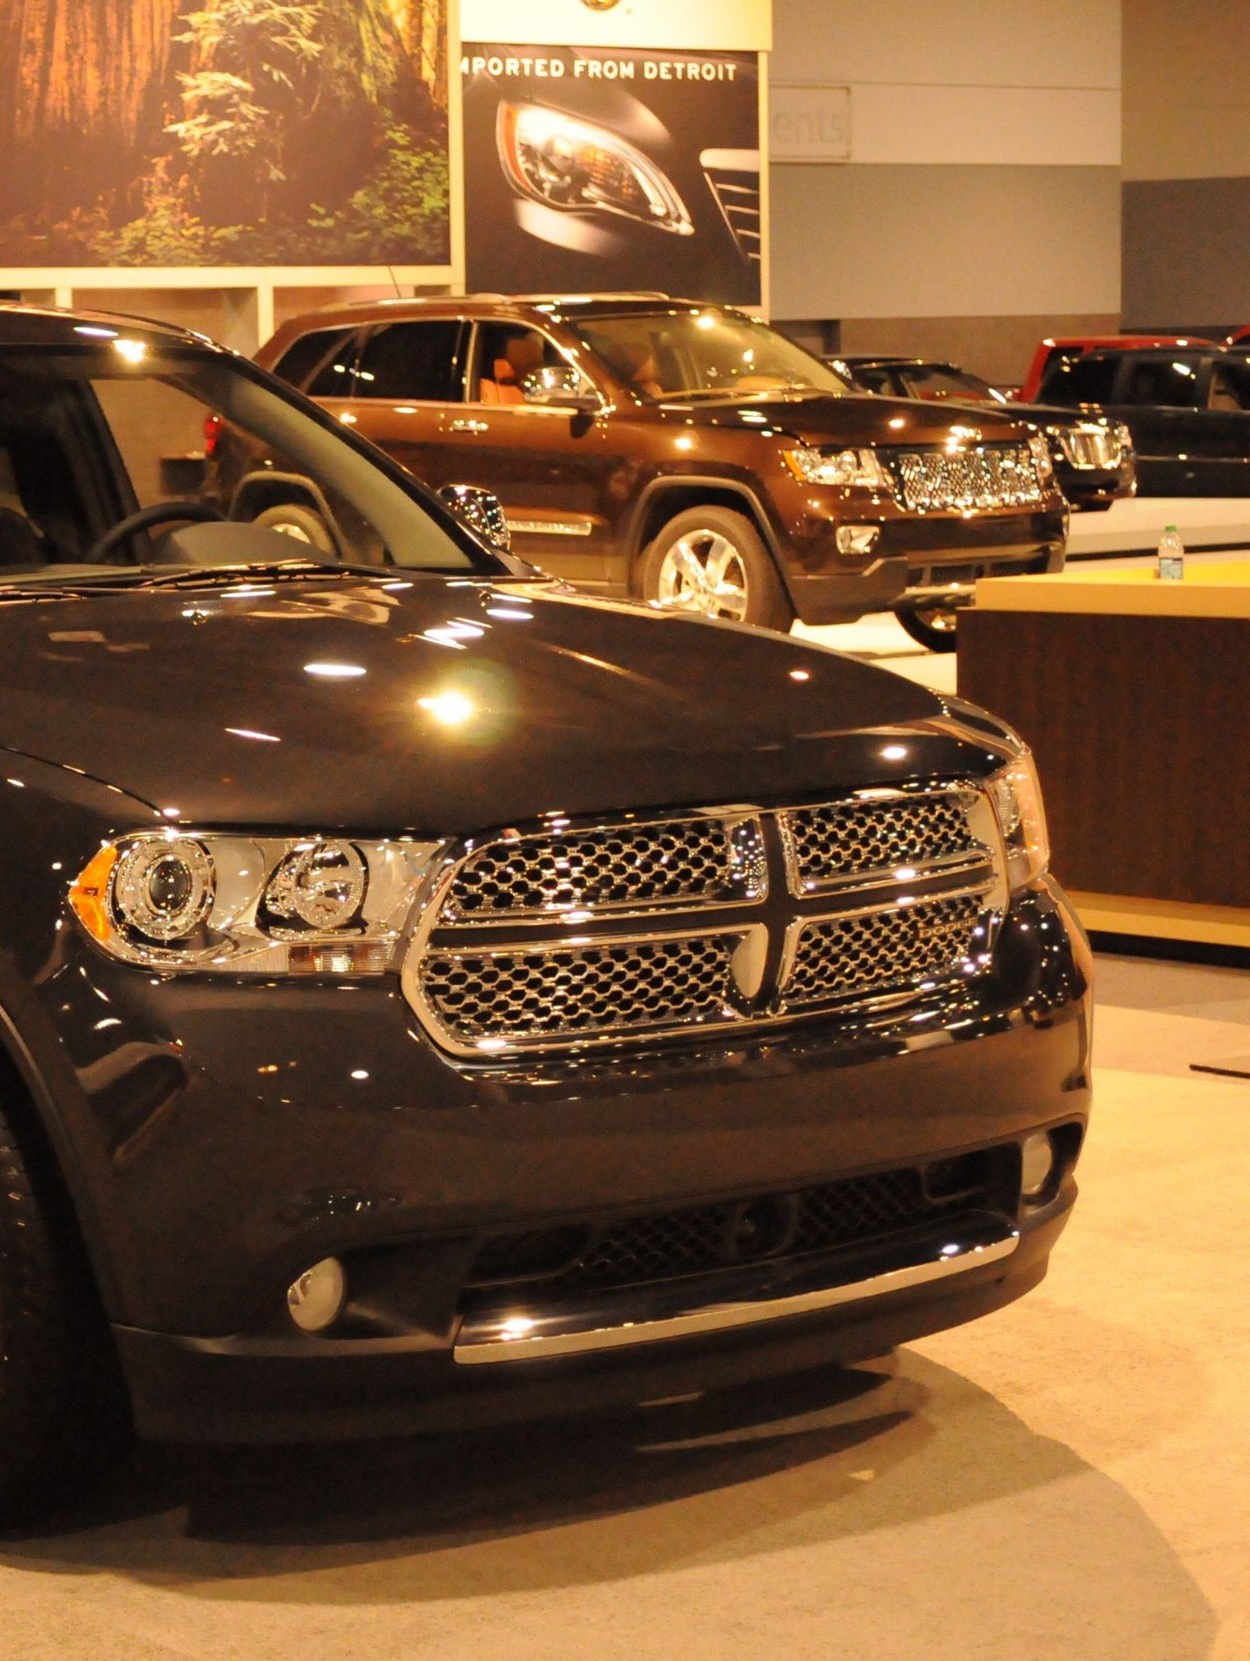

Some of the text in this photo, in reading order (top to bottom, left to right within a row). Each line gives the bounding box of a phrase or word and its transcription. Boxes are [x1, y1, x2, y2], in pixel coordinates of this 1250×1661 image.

[460, 56, 737, 81] MPORTED FROM DETROIT
